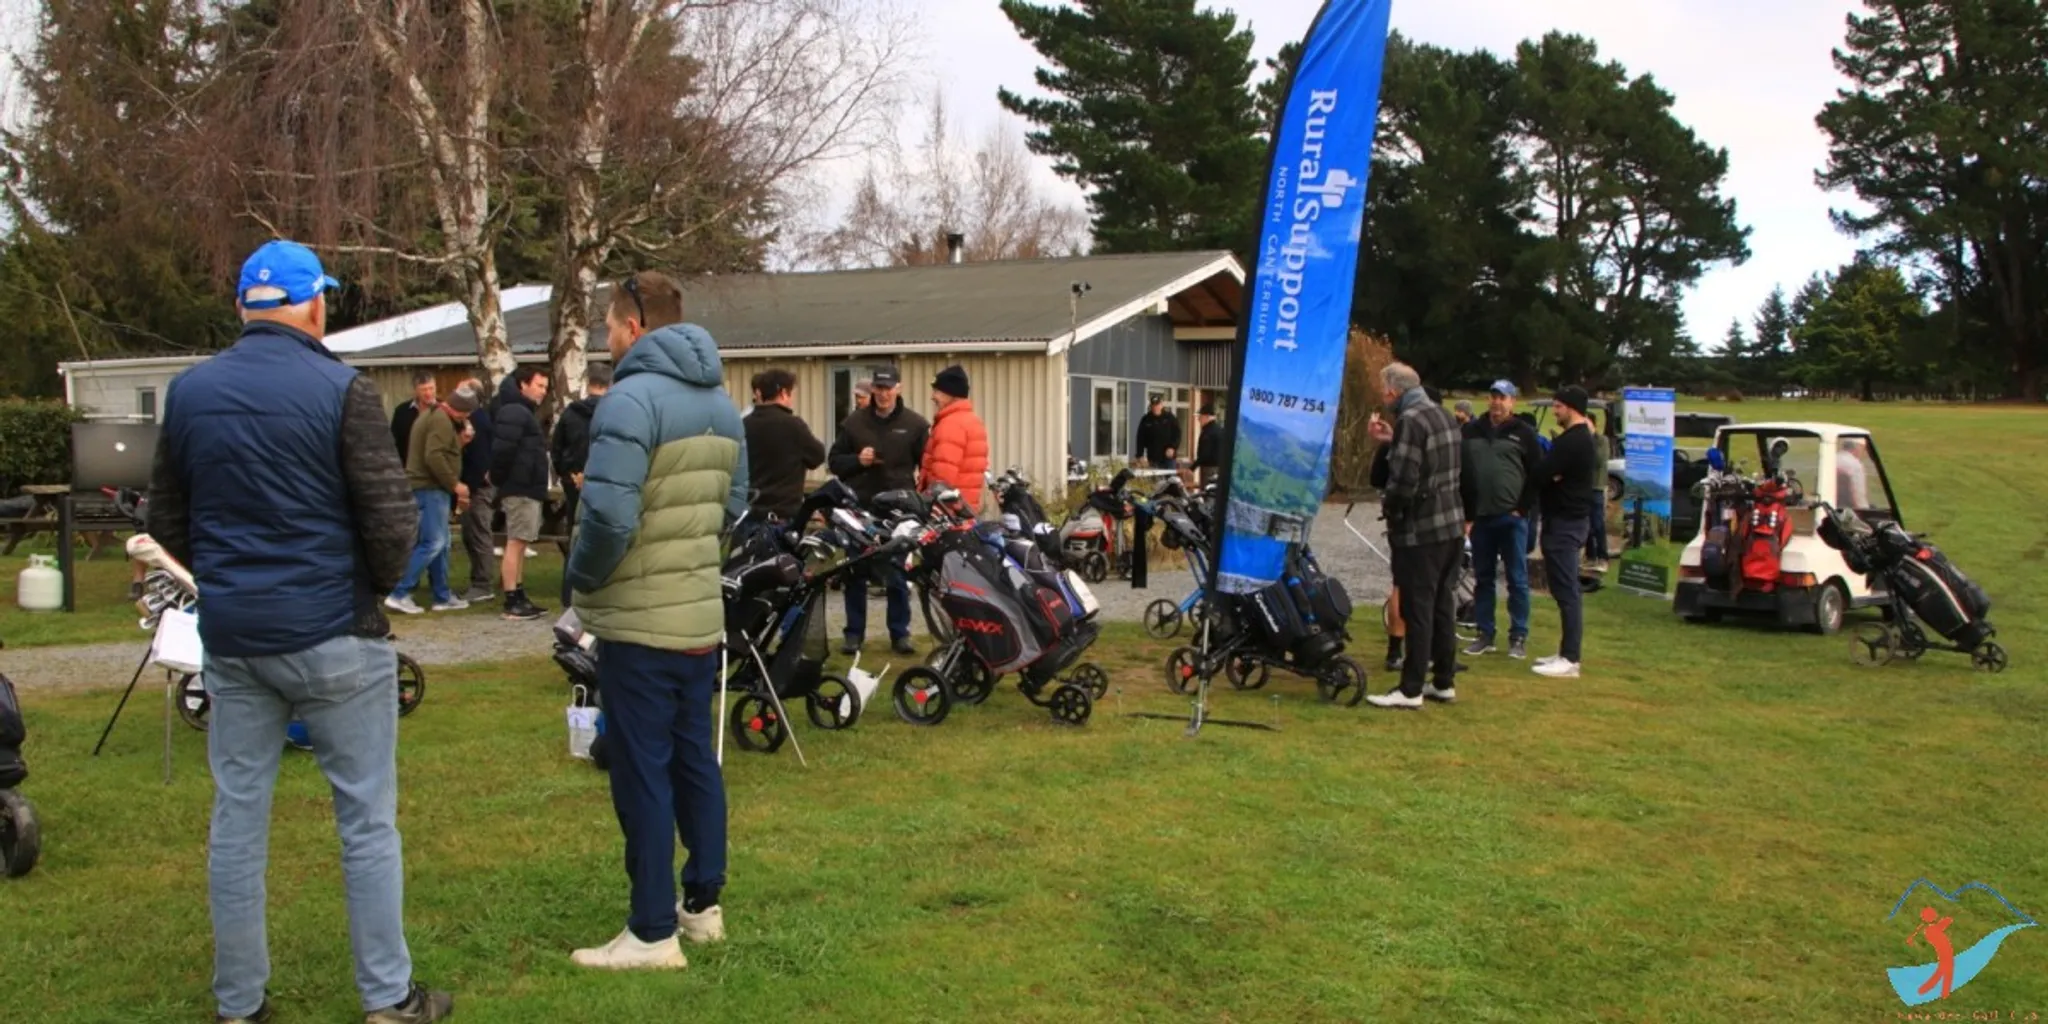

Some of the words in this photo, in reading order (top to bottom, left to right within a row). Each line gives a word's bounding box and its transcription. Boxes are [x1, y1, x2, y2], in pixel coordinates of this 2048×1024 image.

[1272, 166, 1288, 223] NORTH
[1273, 88, 1337, 352] RuralSupport
[1256, 234, 1278, 344] CANTERBURY
[1249, 387, 1274, 404] 0800
[1277, 393, 1298, 408] 787
[1302, 398, 1326, 413] 254
